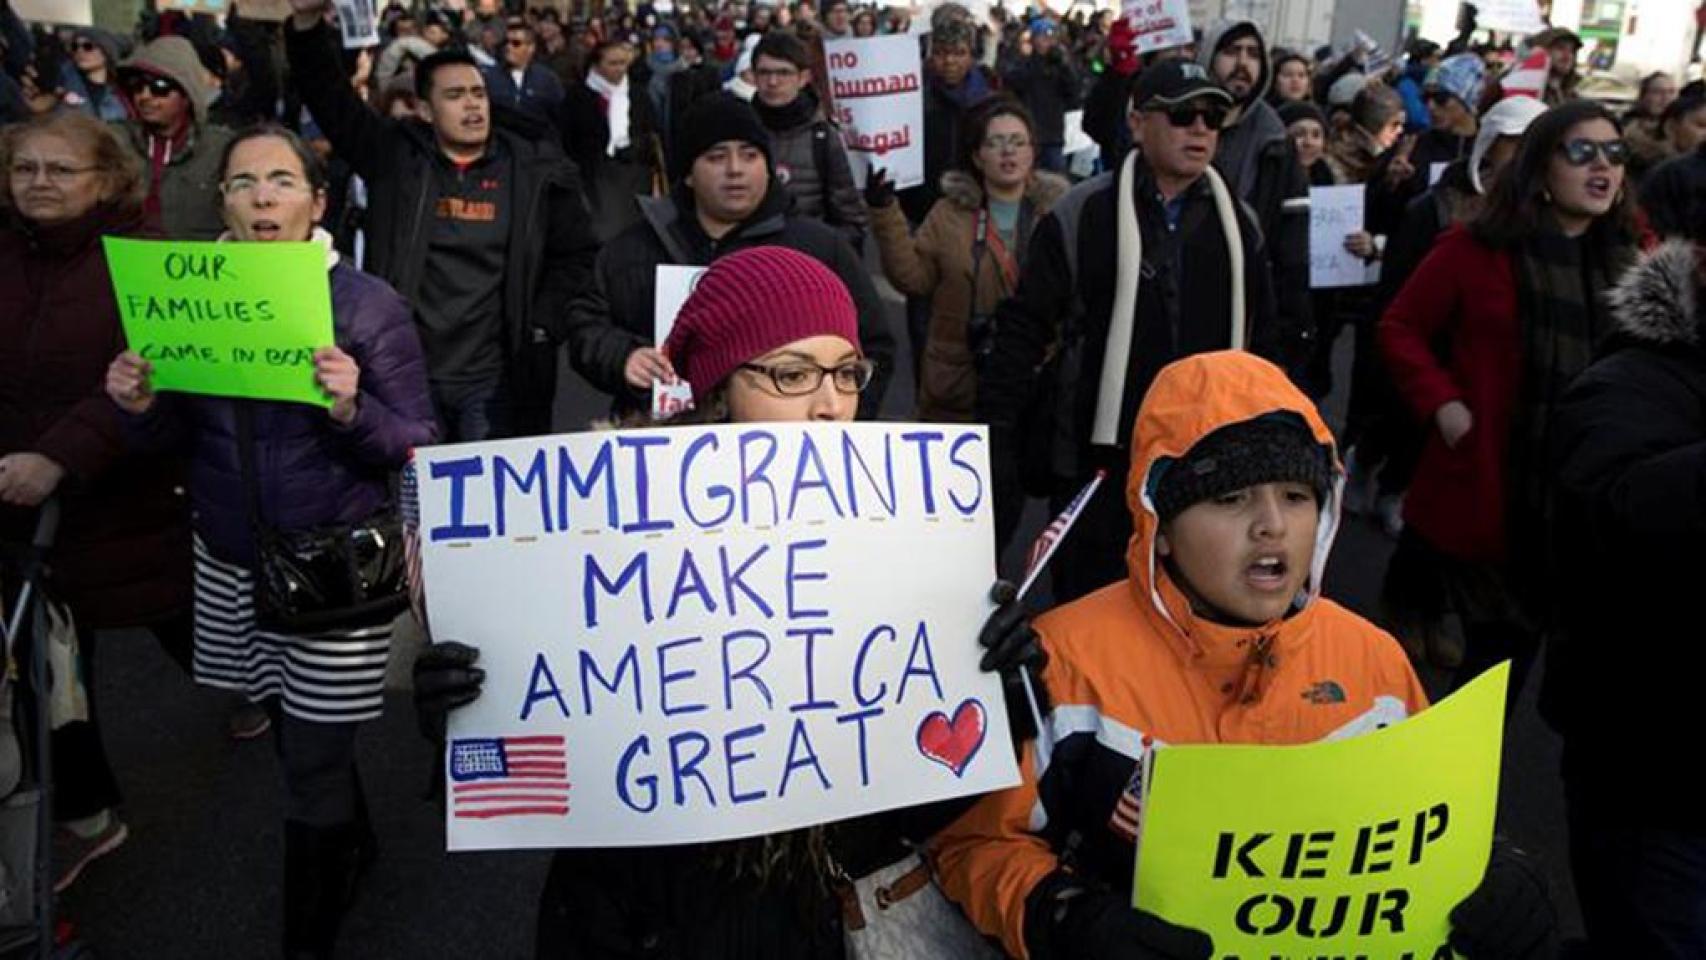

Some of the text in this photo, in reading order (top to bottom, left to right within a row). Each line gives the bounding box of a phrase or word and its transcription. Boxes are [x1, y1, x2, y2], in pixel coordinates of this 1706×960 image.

[829, 51, 857, 69] no
[832, 73, 918, 97] human
[163, 252, 235, 281] OUR
[127, 295, 275, 324] FAMILIES
[139, 343, 220, 364] CAME
[232, 347, 255, 363] IN
[430, 430, 984, 541] IMMIGRANTS
[582, 539, 830, 628] MAKE
[519, 619, 945, 722] AMERICA
[615, 706, 885, 814] GREAT
[1211, 802, 1451, 880] KEEP
[1234, 888, 1410, 938] OUR
